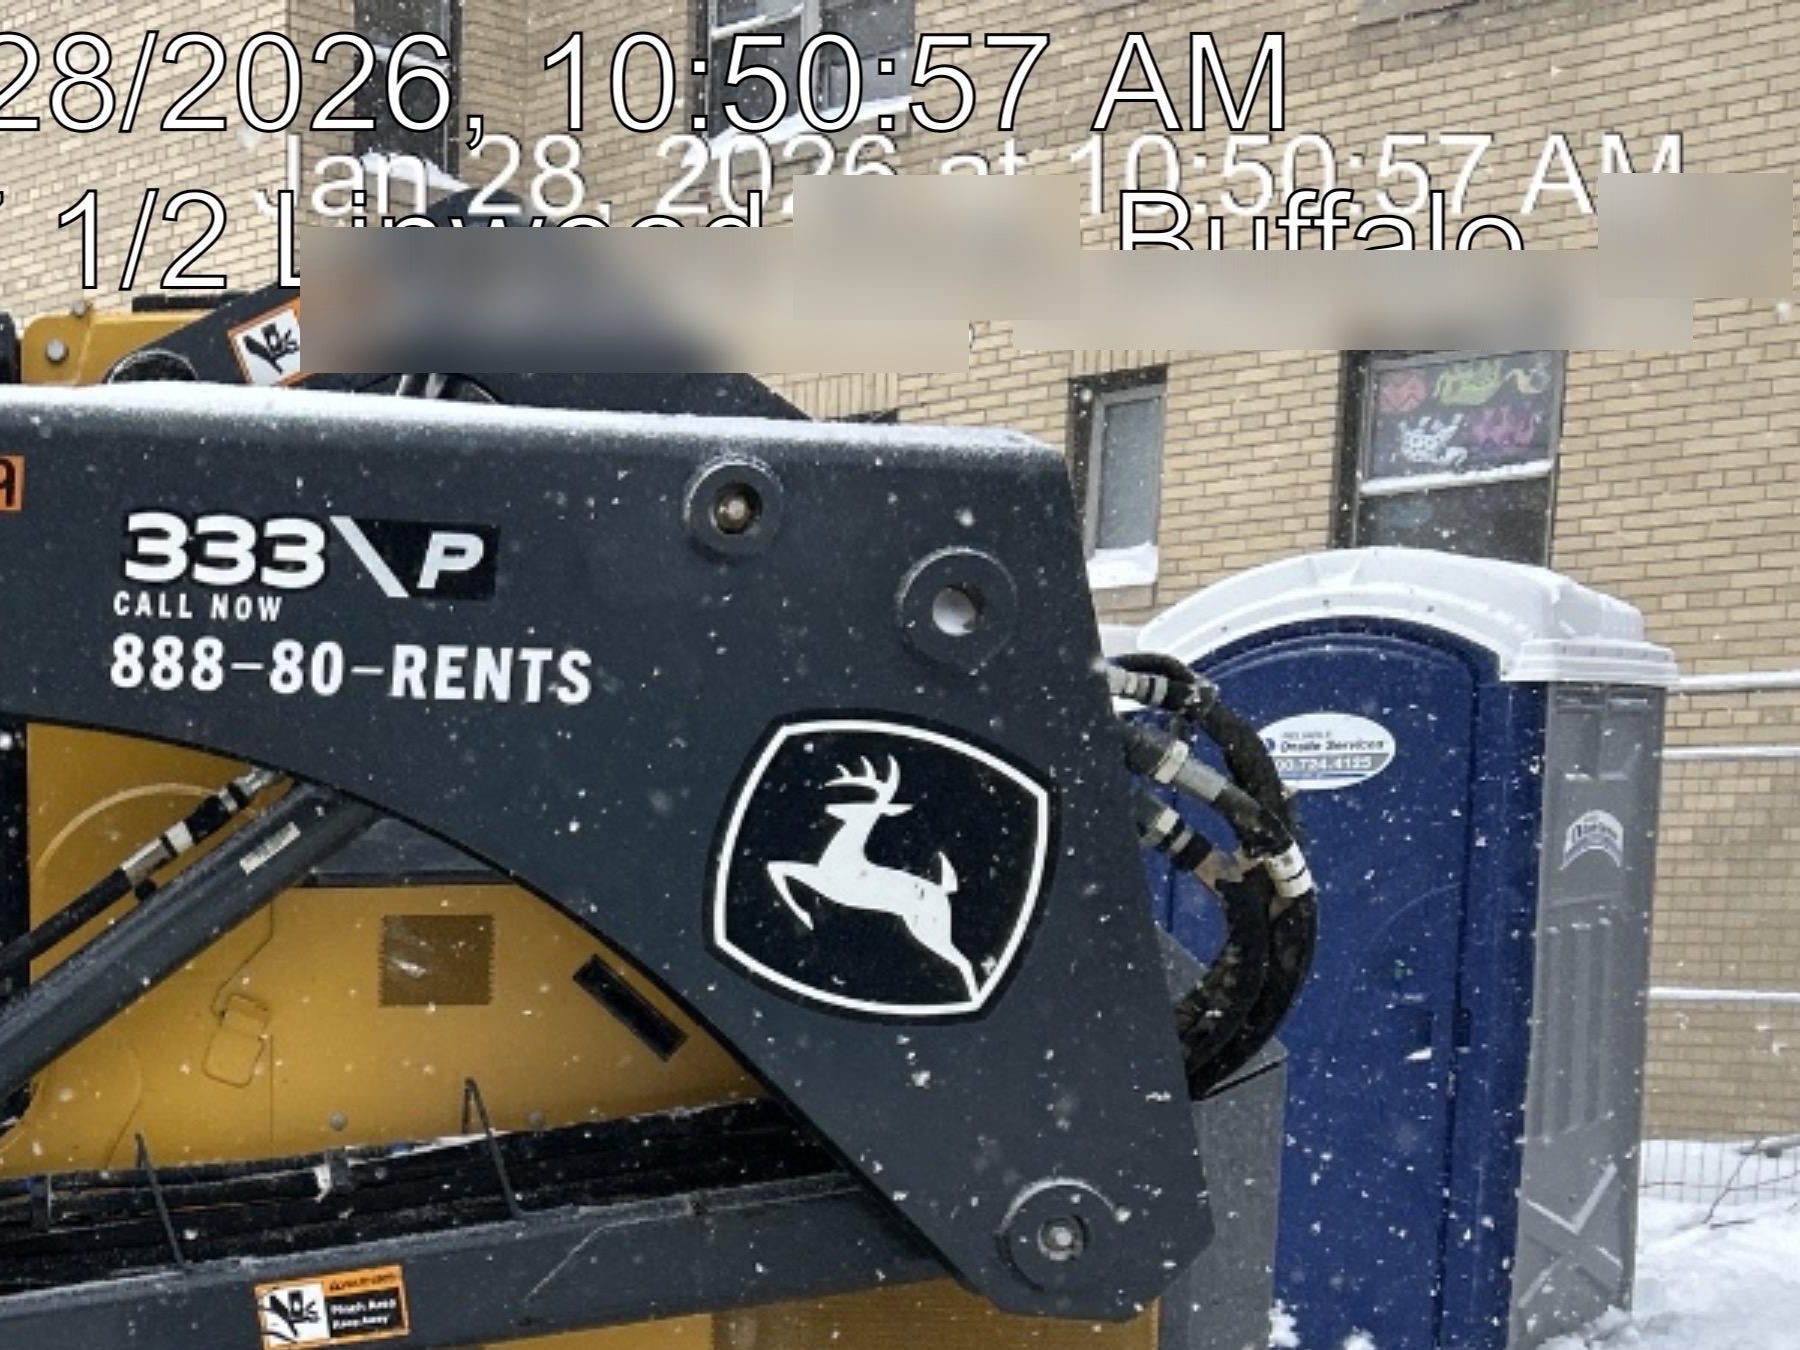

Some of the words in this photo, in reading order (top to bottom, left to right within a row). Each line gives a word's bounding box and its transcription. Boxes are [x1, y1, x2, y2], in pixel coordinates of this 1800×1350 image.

[113, 590, 193, 618] CALL
[210, 595, 282, 622] NOW
[109, 634, 593, 706] 888-80-RENTS
